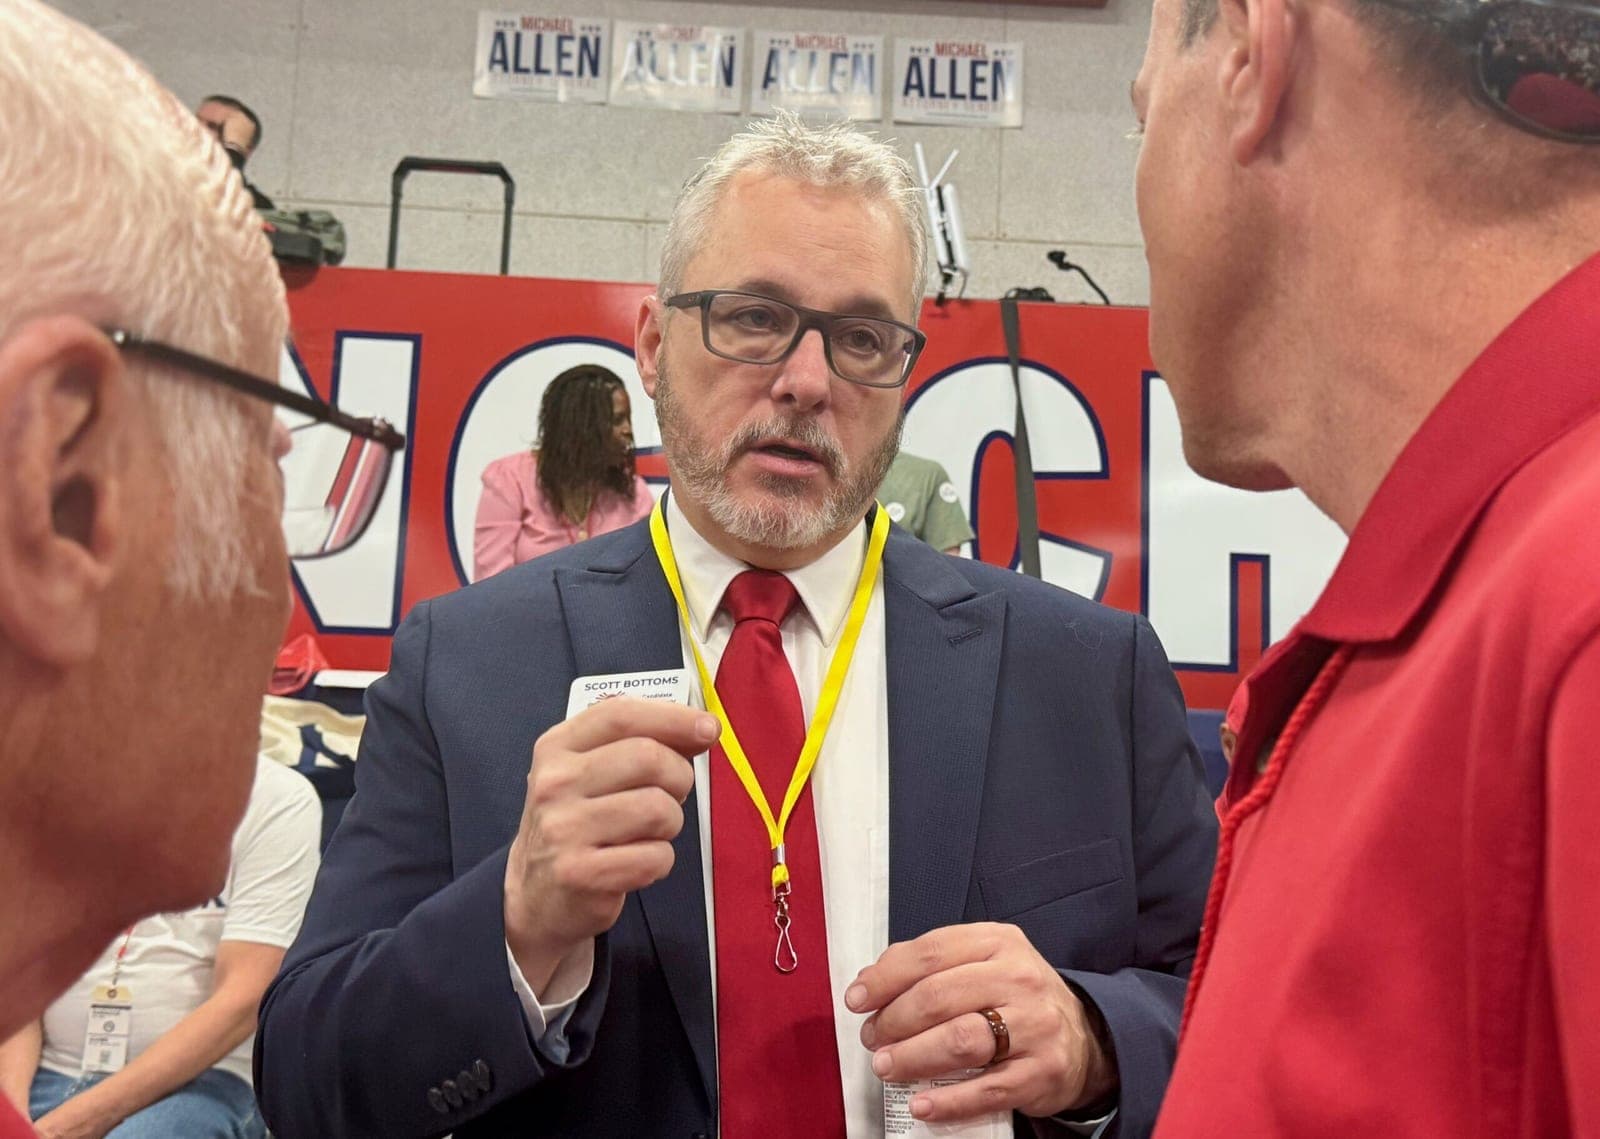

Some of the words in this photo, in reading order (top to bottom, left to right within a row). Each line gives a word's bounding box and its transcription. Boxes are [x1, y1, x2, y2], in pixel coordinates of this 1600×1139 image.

[520, 16, 574, 33] MICHAEL
[488, 31, 601, 78] ALLEN
[934, 41, 987, 58] MICHAEL
[762, 48, 875, 96] ALLEN
[903, 56, 1014, 104] ALLEN
[584, 680, 621, 691] SCOTT
[623, 676, 679, 688] BOTTOMS
